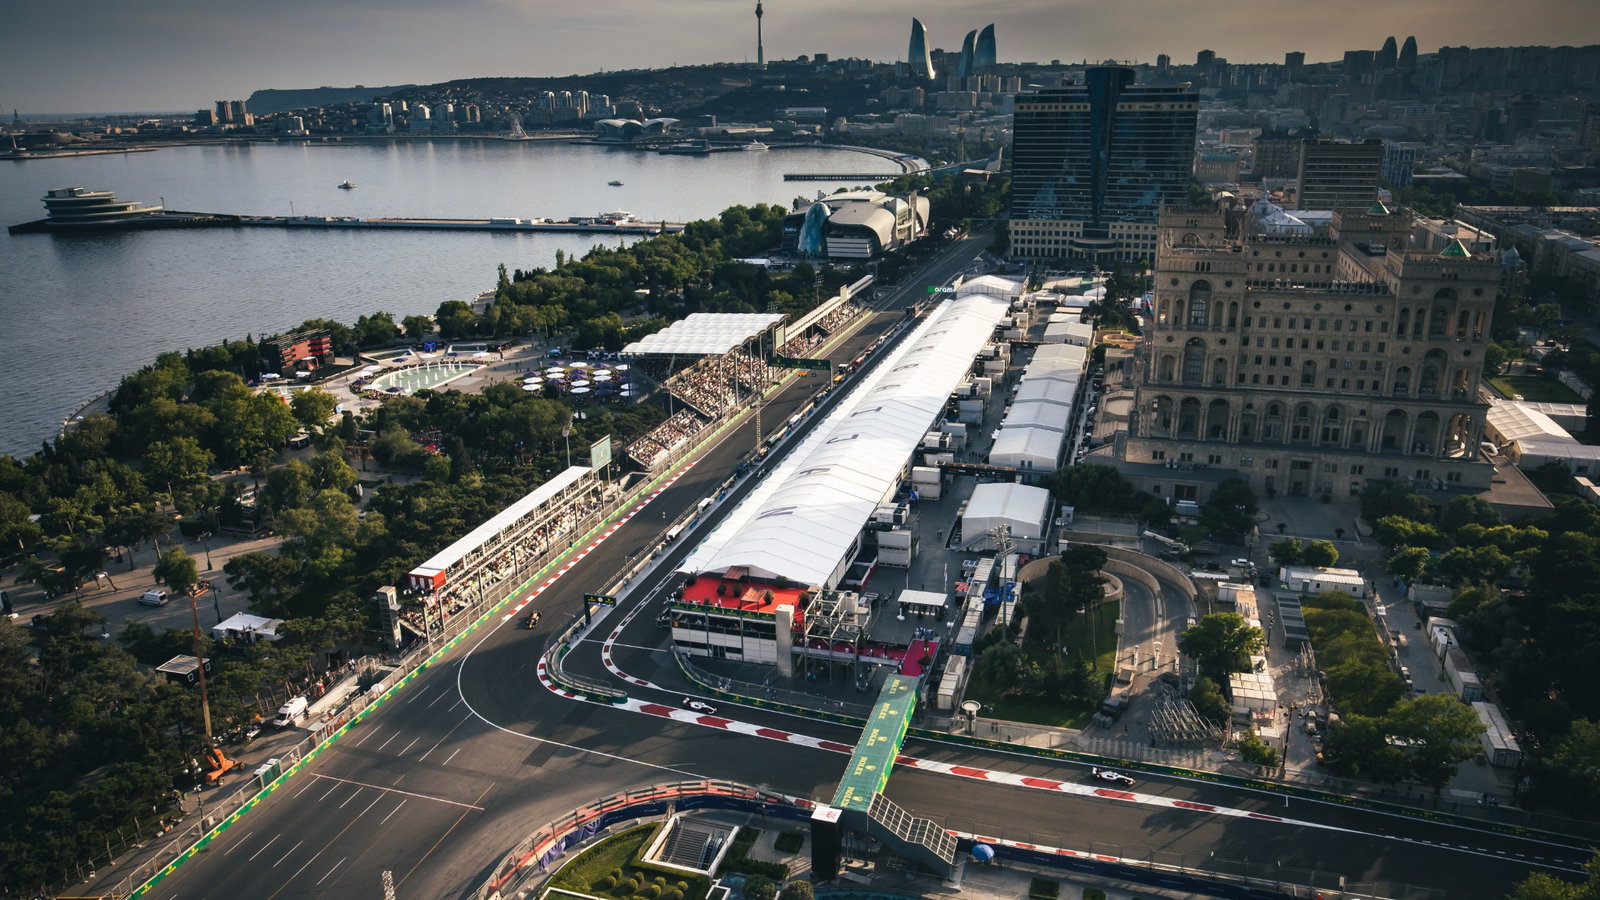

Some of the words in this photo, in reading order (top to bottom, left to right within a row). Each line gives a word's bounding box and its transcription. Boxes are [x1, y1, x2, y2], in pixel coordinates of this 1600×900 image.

[879, 703, 890, 719] ROLEX
[867, 728, 880, 746] ROLEX
[855, 757, 868, 775] ROLEX
[841, 787, 855, 807] ROLEX
